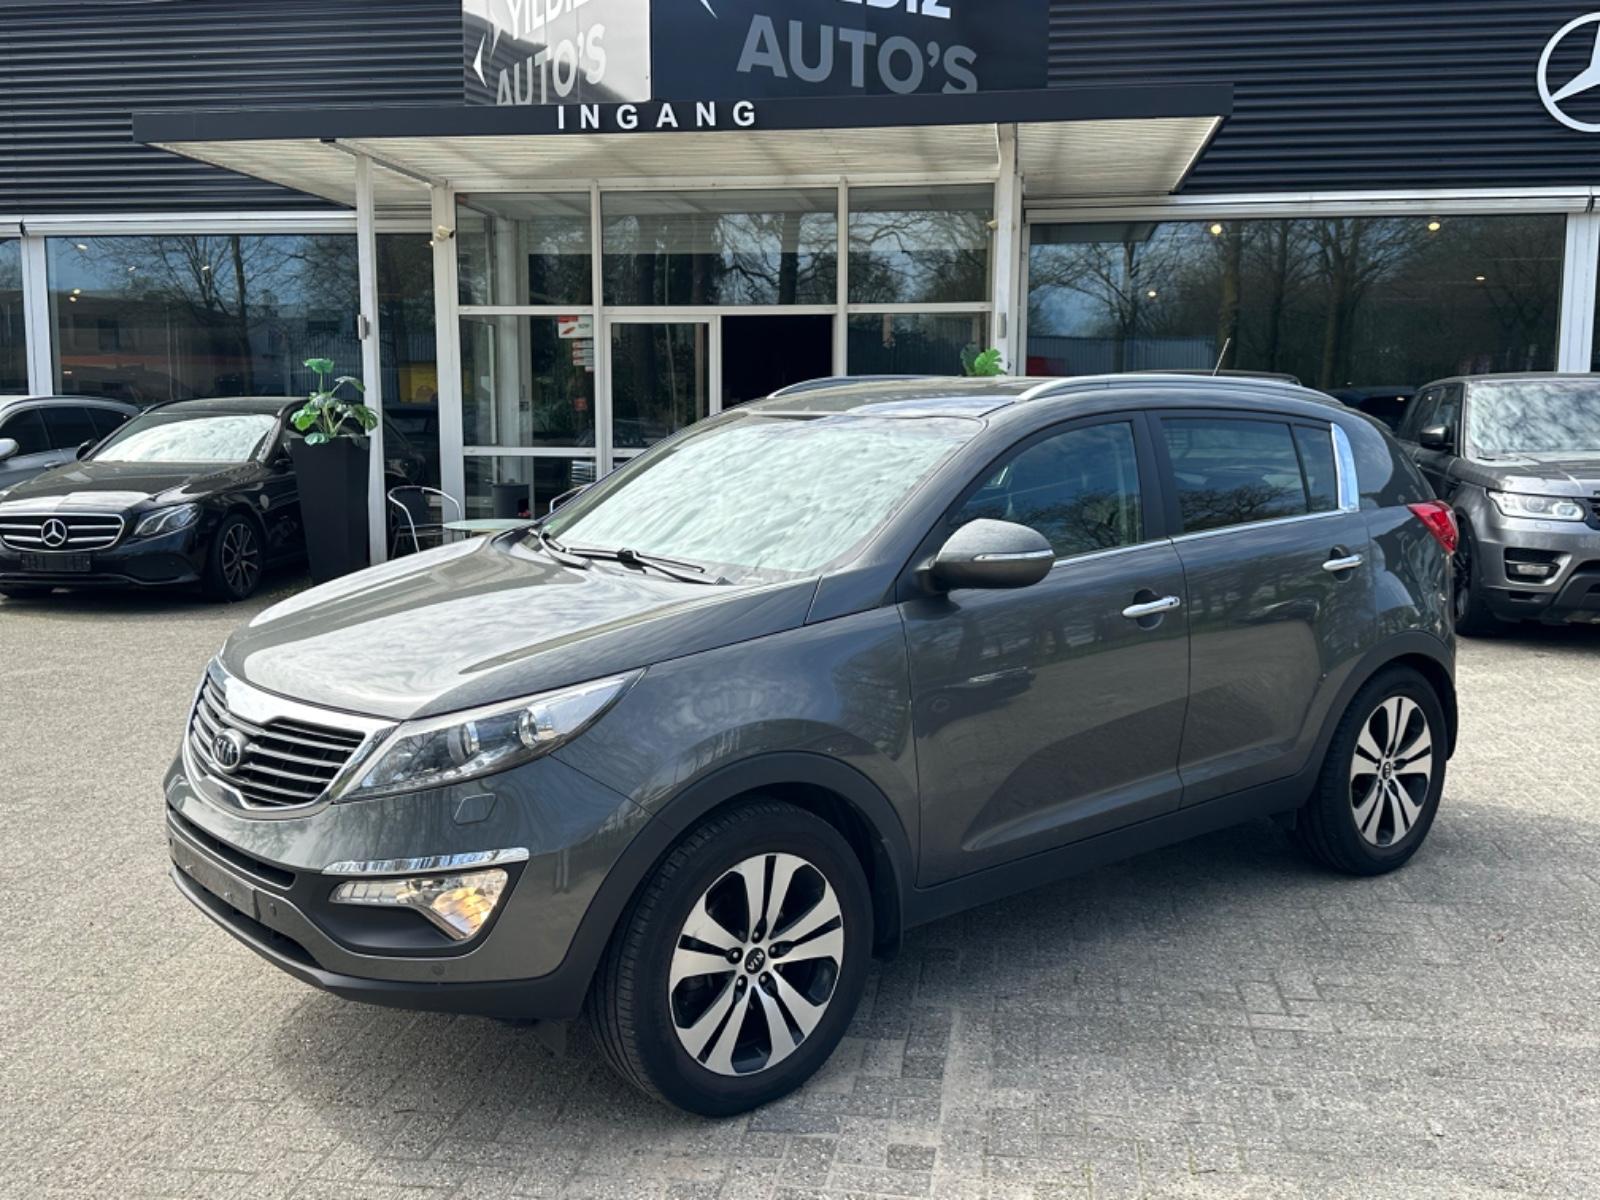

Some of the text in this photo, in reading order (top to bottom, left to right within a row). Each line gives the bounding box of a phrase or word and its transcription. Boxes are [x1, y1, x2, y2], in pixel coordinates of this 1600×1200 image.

[497, 23, 606, 105] AUTO'S
[736, 14, 978, 95] AUTO'S
[558, 101, 755, 129] INGANG
